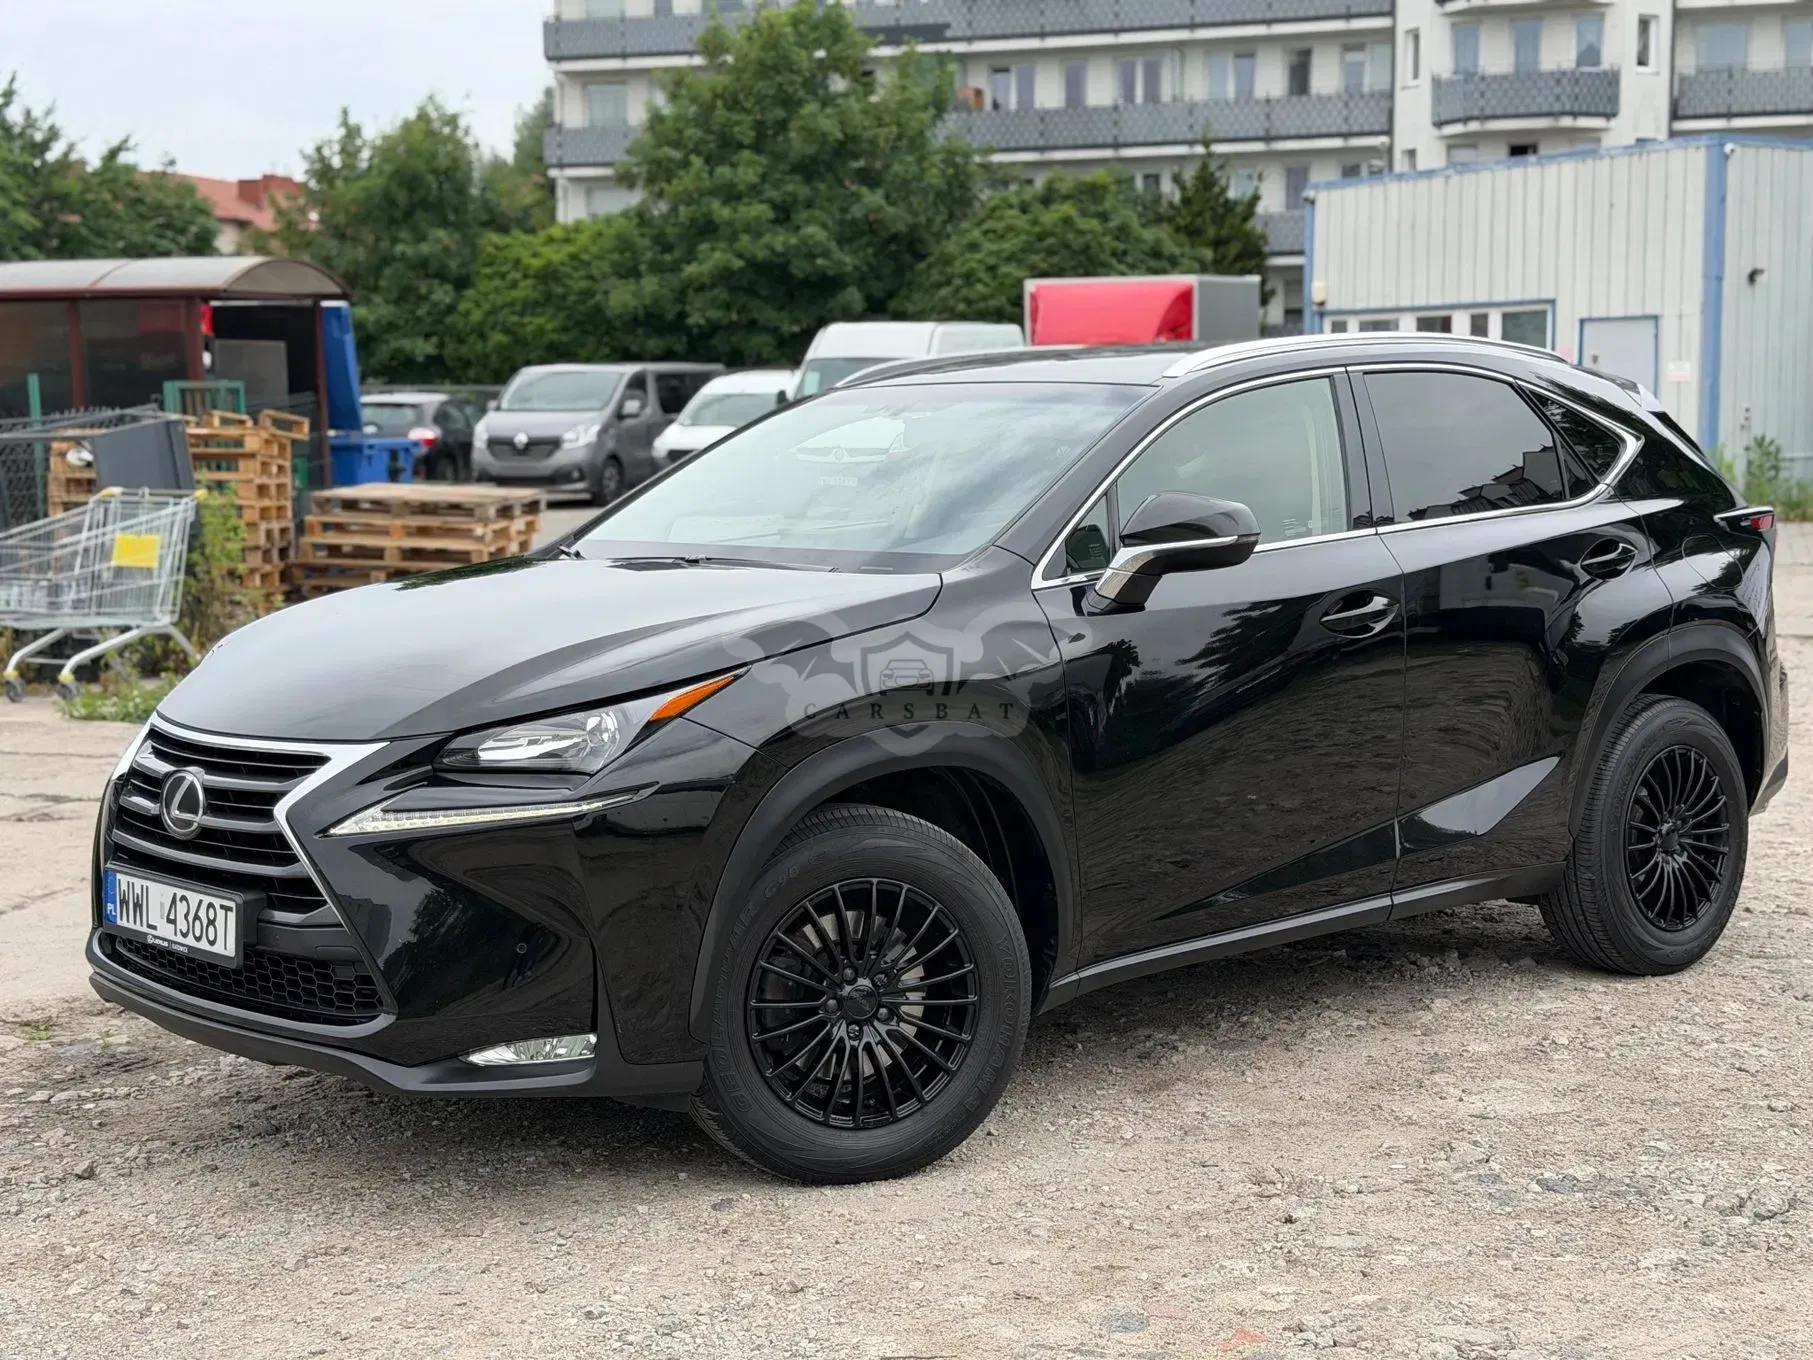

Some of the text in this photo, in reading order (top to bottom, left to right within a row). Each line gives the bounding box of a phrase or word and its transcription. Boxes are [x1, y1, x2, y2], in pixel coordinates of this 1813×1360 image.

[107, 902, 117, 916] PL
[118, 878, 234, 950] WWL 4368T
